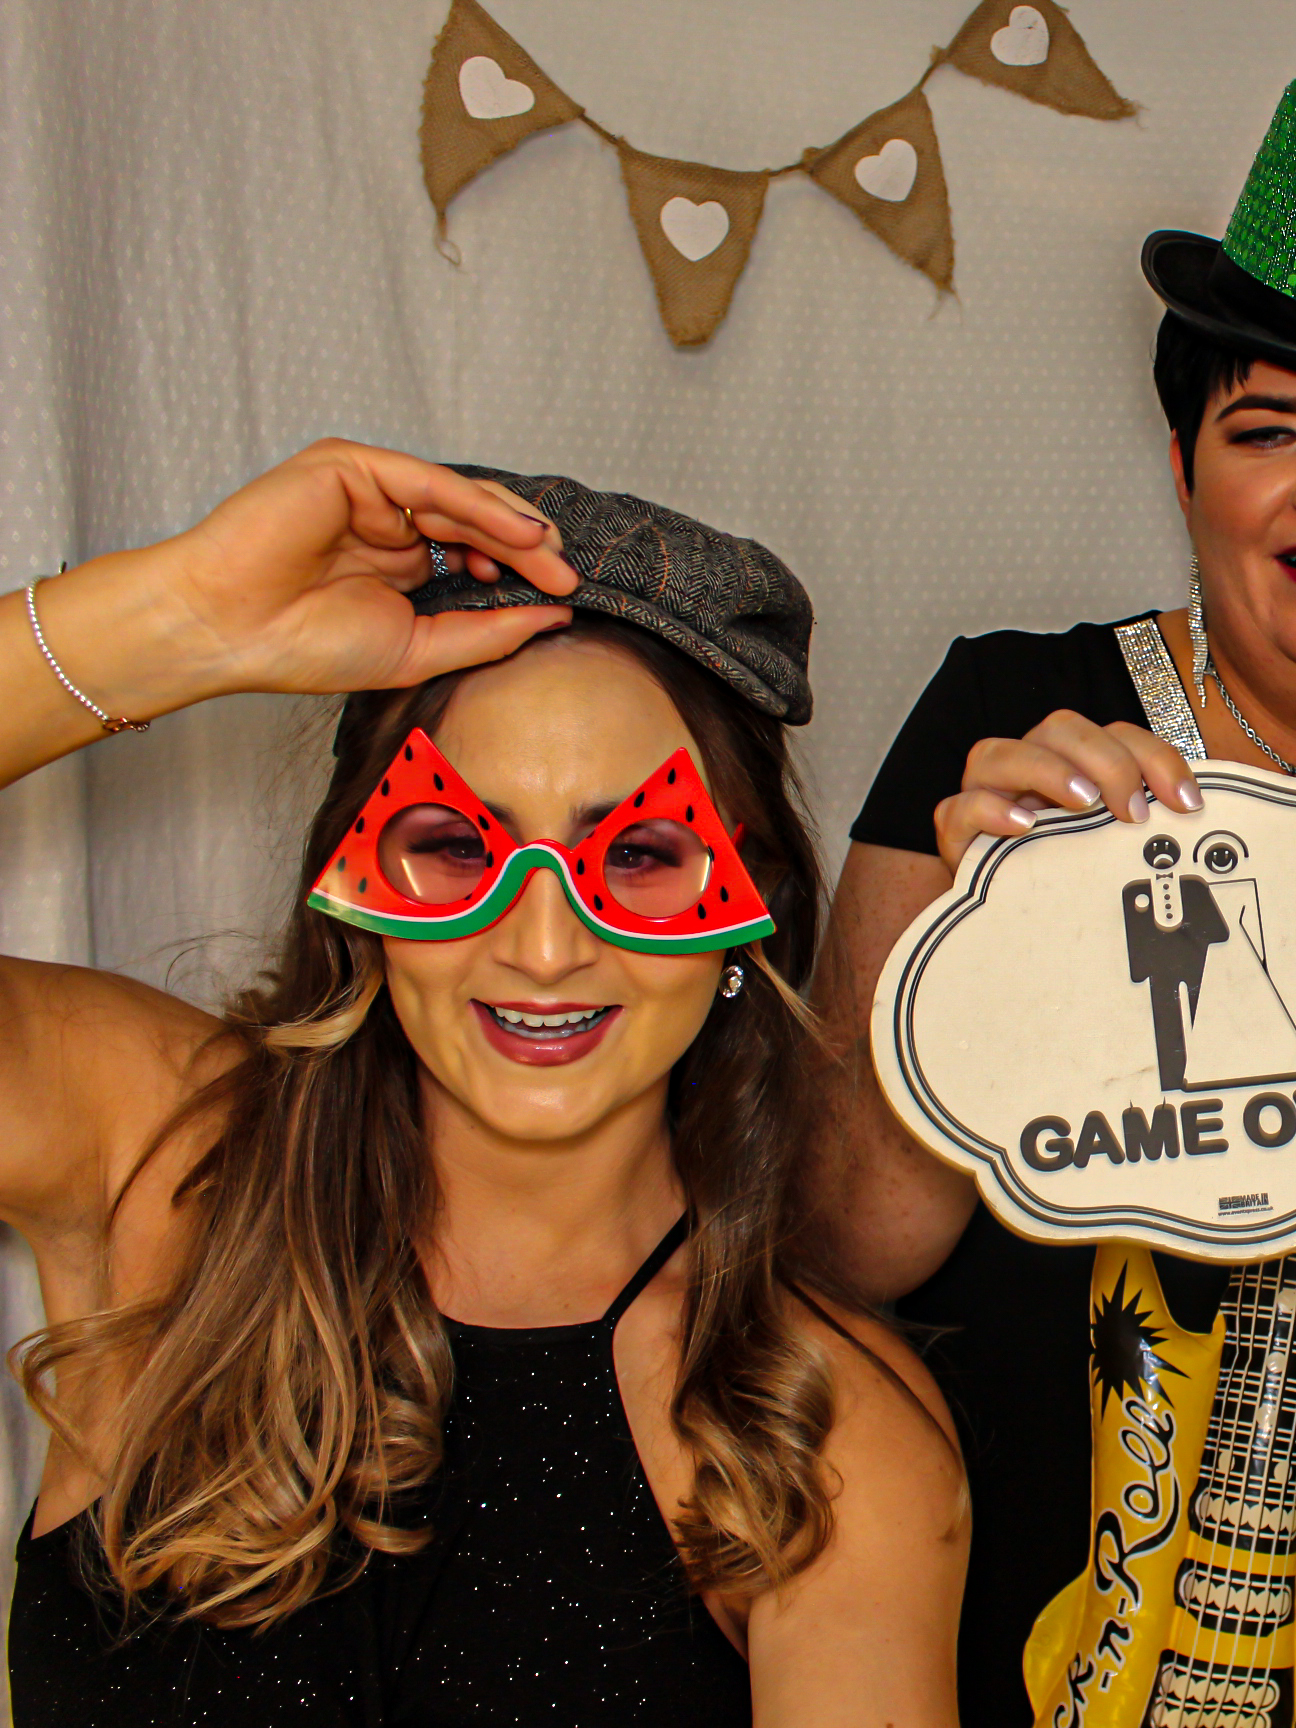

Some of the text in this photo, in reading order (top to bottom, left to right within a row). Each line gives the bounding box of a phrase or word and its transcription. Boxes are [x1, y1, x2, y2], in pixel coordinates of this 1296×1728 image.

[1020, 1098, 1229, 1172] GAME
[1240, 1192, 1269, 1201] MADE IN
[1240, 1199, 1269, 1207] BRITAIN
